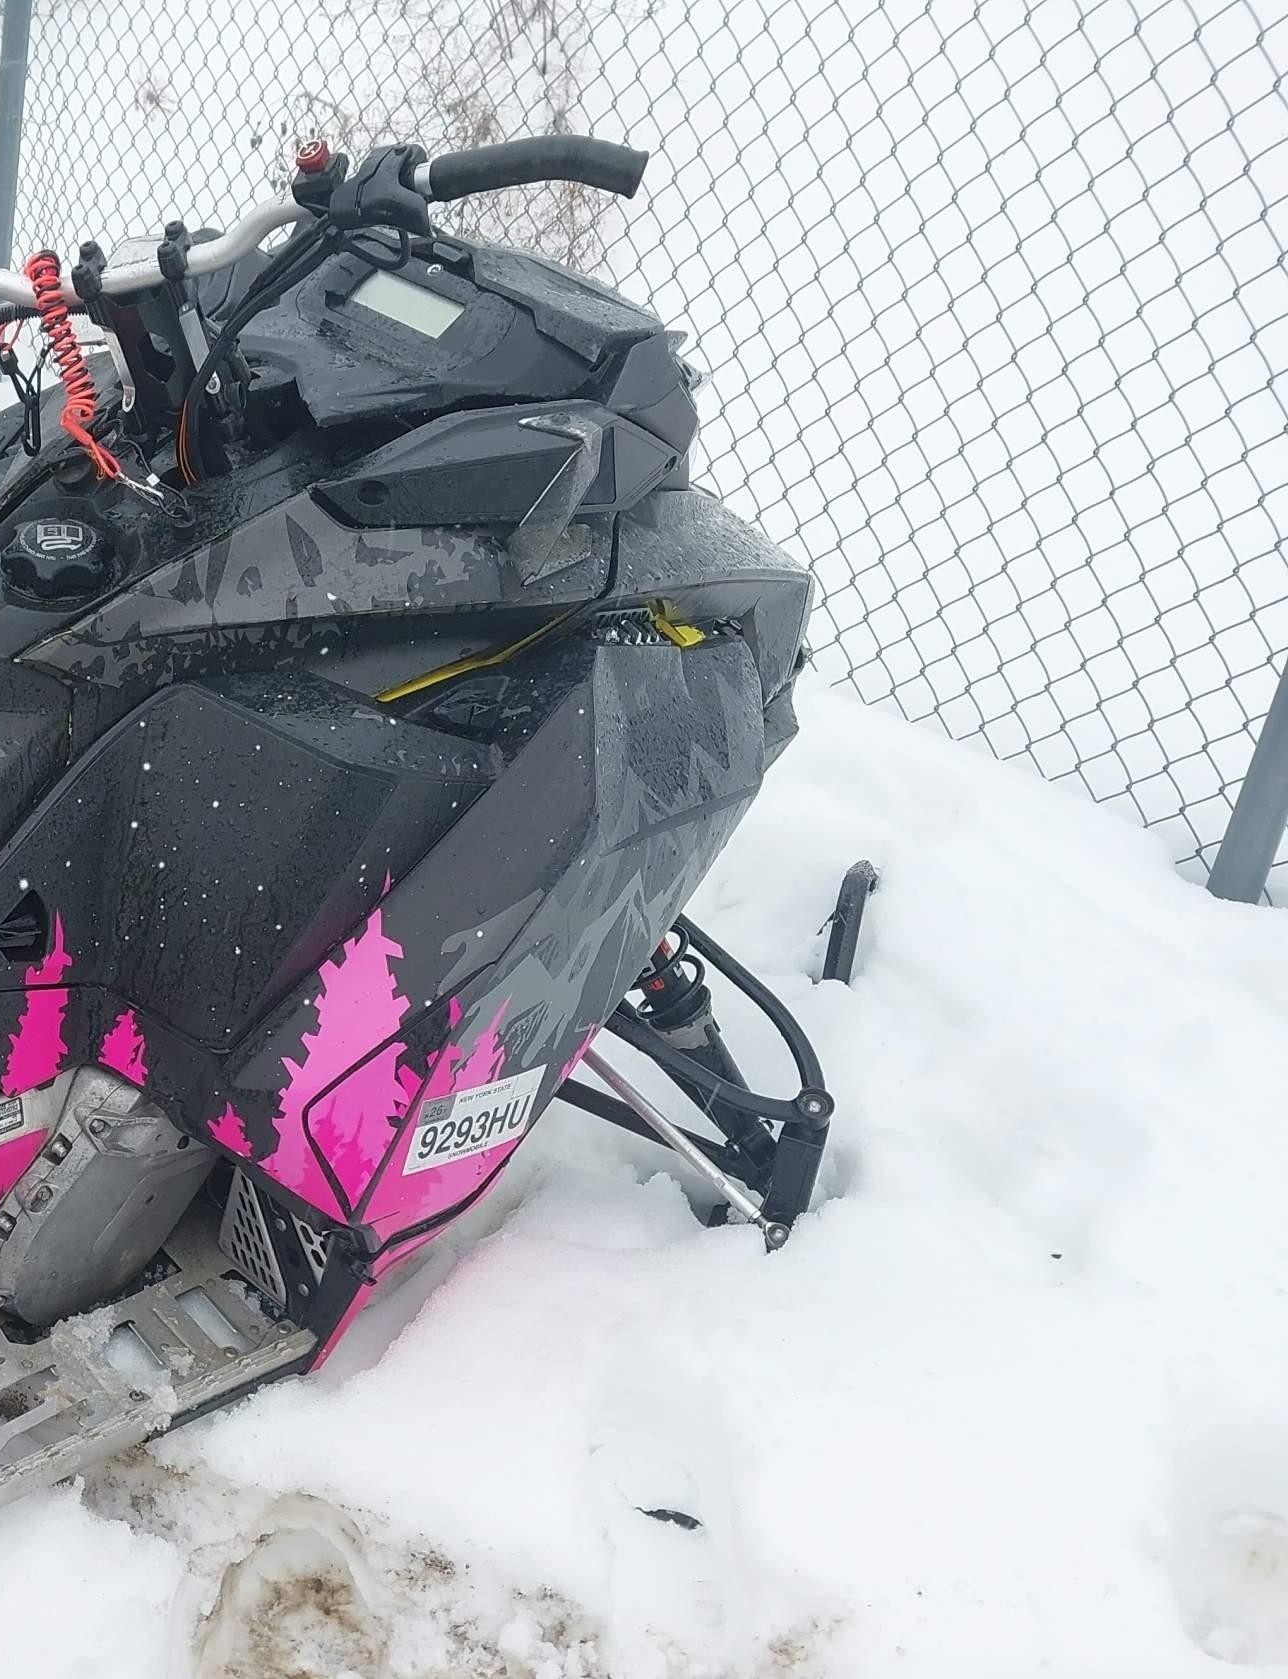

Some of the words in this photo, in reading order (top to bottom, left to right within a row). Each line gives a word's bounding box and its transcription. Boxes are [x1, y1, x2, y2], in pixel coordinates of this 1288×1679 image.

[458, 1094, 474, 1105] NEW
[474, 1089, 492, 1100] YORK
[492, 1083, 512, 1095] STATE
[417, 1094, 531, 1160] 9293HU
[447, 1141, 489, 1160] SNOWMOBILE
